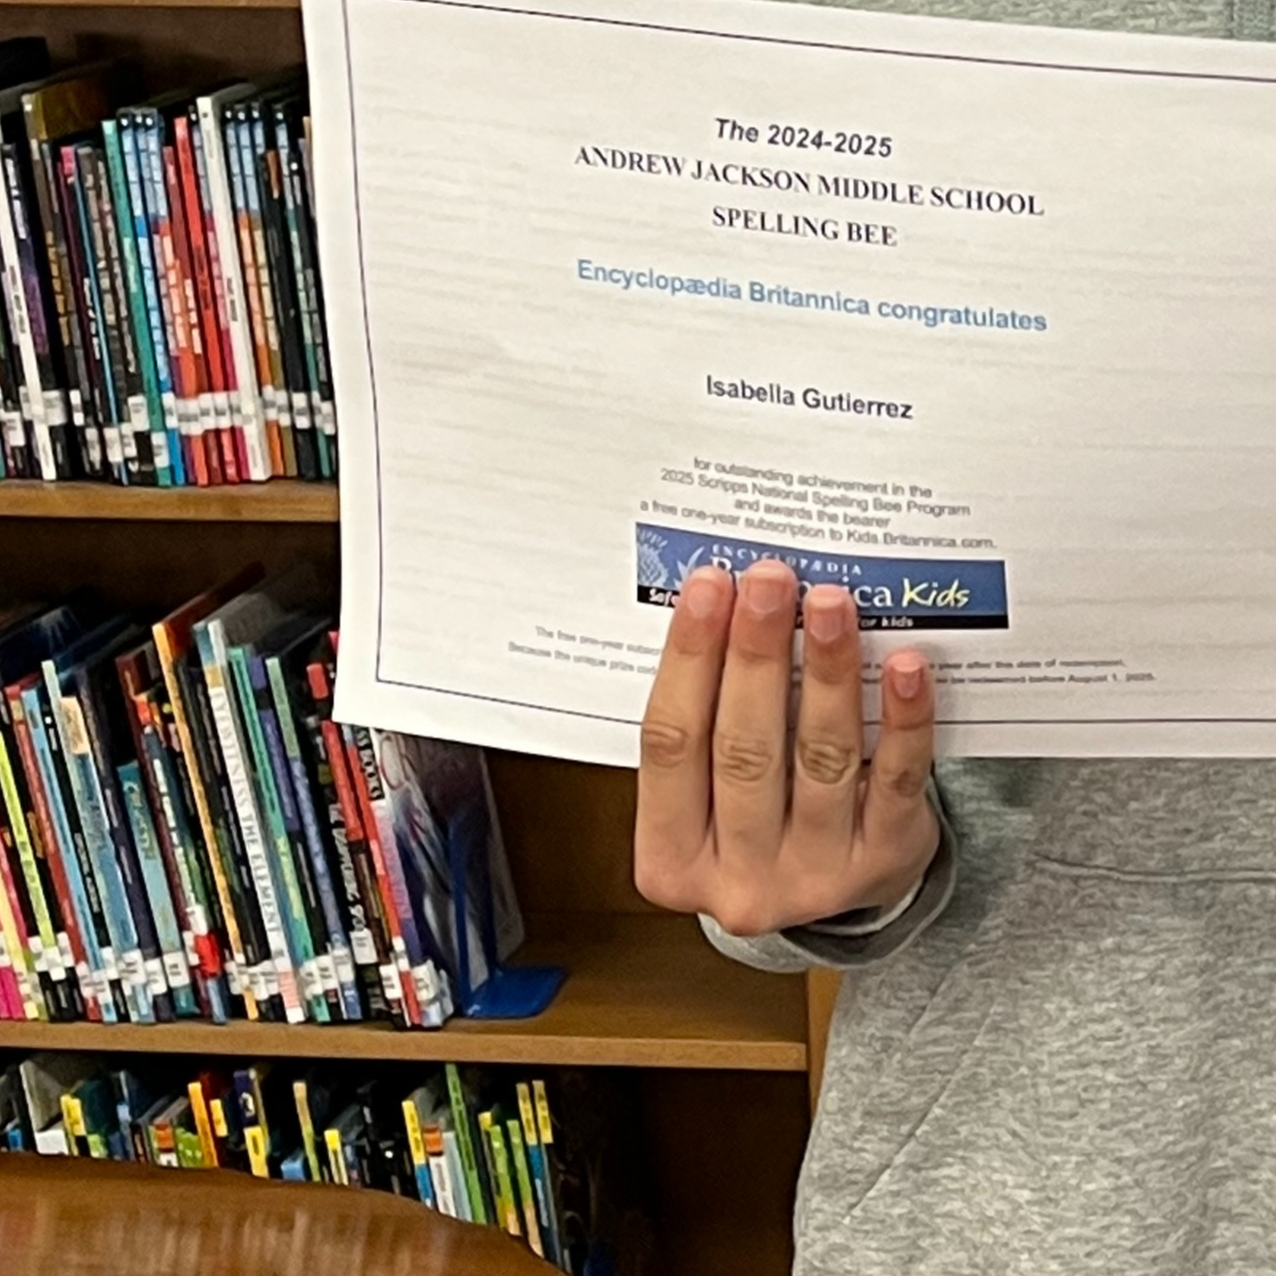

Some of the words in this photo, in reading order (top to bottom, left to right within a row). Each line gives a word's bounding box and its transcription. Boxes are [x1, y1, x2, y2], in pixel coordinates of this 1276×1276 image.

[714, 118, 759, 143] The
[767, 125, 893, 158] 2024-2025
[574, 146, 687, 177] ANDREW
[690, 160, 811, 194] JACKSON
[816, 175, 925, 206] MIDDLE
[929, 187, 1045, 217] SCHOOL
[711, 206, 840, 242] SPELLING
[846, 224, 899, 247] BEE
[577, 259, 743, 301] Encyclopædia
[749, 282, 870, 316] Britannica
[877, 297, 1047, 331] congratulates
[706, 375, 796, 407] Isabella
[802, 388, 914, 420] Gutierrez
[660, 467, 695, 486] 2025
[697, 474, 749, 496] Scripps
[751, 483, 809, 504] National
[811, 491, 869, 512] Spelling
[872, 498, 902, 513] Bee
[906, 500, 971, 518] Program
[693, 456, 711, 471] for
[714, 459, 794, 487] outstanding
[797, 472, 889, 496] achievement
[891, 483, 905, 496] in
[909, 483, 932, 498] the
[652, 500, 679, 516] free
[681, 504, 741, 528] one-year
[744, 515, 826, 541] subscription
[829, 527, 843, 541] to
[734, 497, 759, 512] and
[763, 502, 813, 522] awards
[817, 509, 838, 524] the
[843, 513, 890, 529] bearer
[901, 578, 970, 608] Kids
[880, 615, 914, 628] kids
[210, 692, 252, 808] EYEWITNESS
[241, 813, 261, 847] THE
[359, 749, 385, 798] BOOKS
[327, 803, 344, 824] THE
